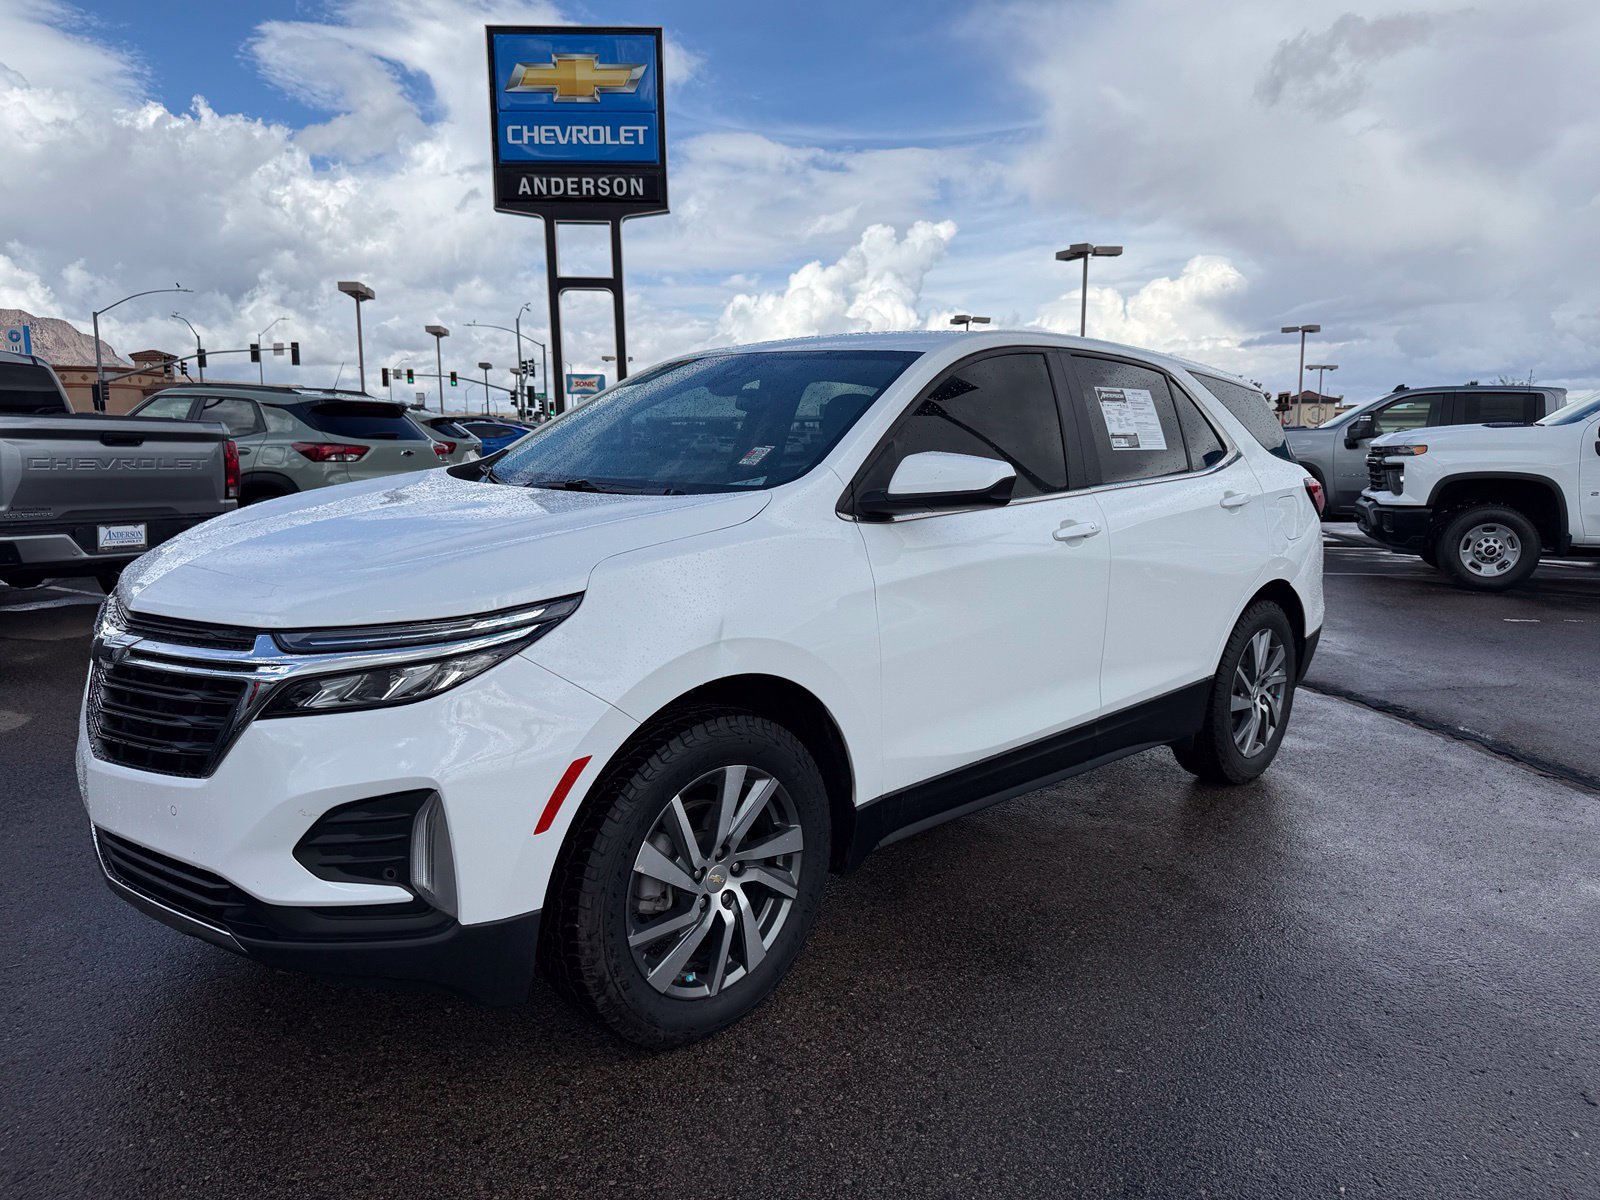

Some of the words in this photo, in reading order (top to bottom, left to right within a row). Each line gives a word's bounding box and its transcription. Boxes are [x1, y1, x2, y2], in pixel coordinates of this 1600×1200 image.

[507, 125, 648, 145] CHEVROLET
[518, 177, 644, 196] ANDERSON
[574, 380, 596, 388] SONIC
[27, 457, 208, 471] CHEVROLET
[101, 530, 143, 545] ANDERSON
